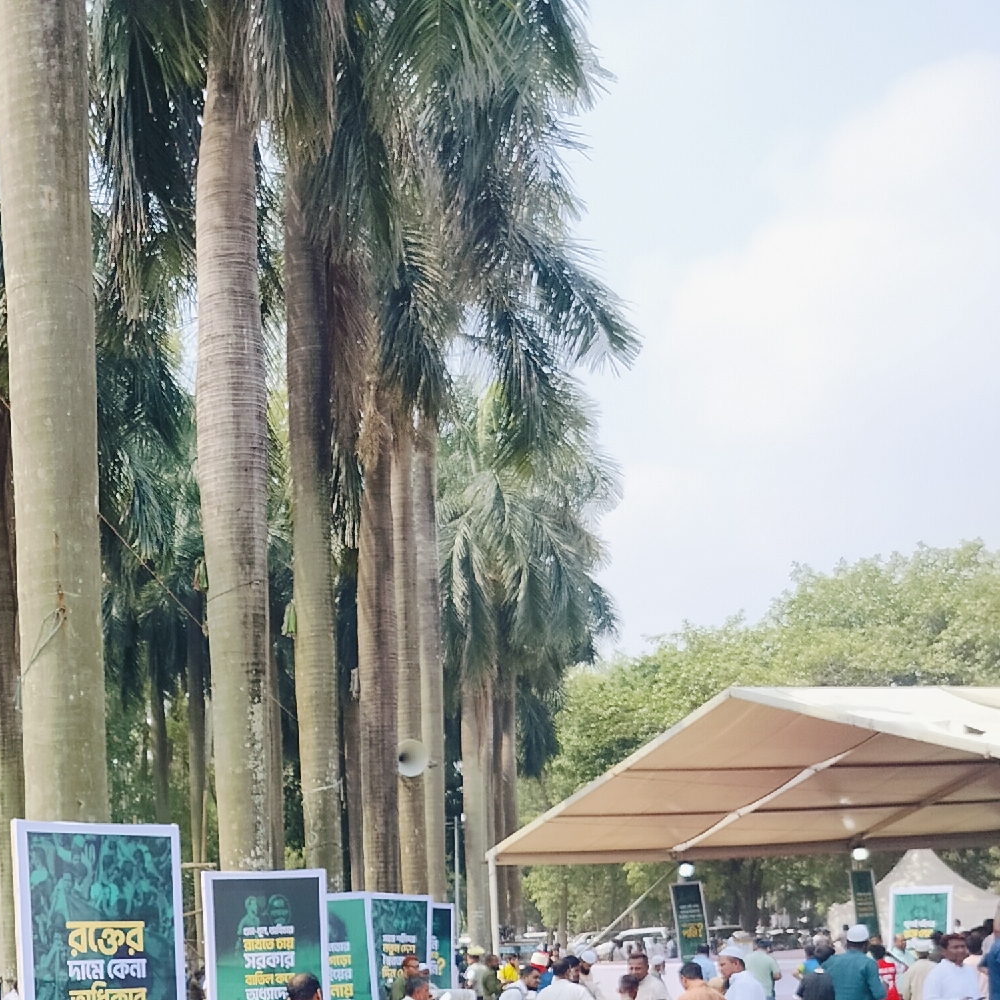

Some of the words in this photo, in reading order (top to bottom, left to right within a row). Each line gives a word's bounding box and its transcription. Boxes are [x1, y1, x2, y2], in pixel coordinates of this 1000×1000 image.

[66, 920, 145, 957] রক্তের
[67, 959, 105, 980] দামে
[107, 958, 147, 979] কেনা
[243, 951, 295, 969] সরকার
[245, 986, 289, 1000] অধ্যাদে
